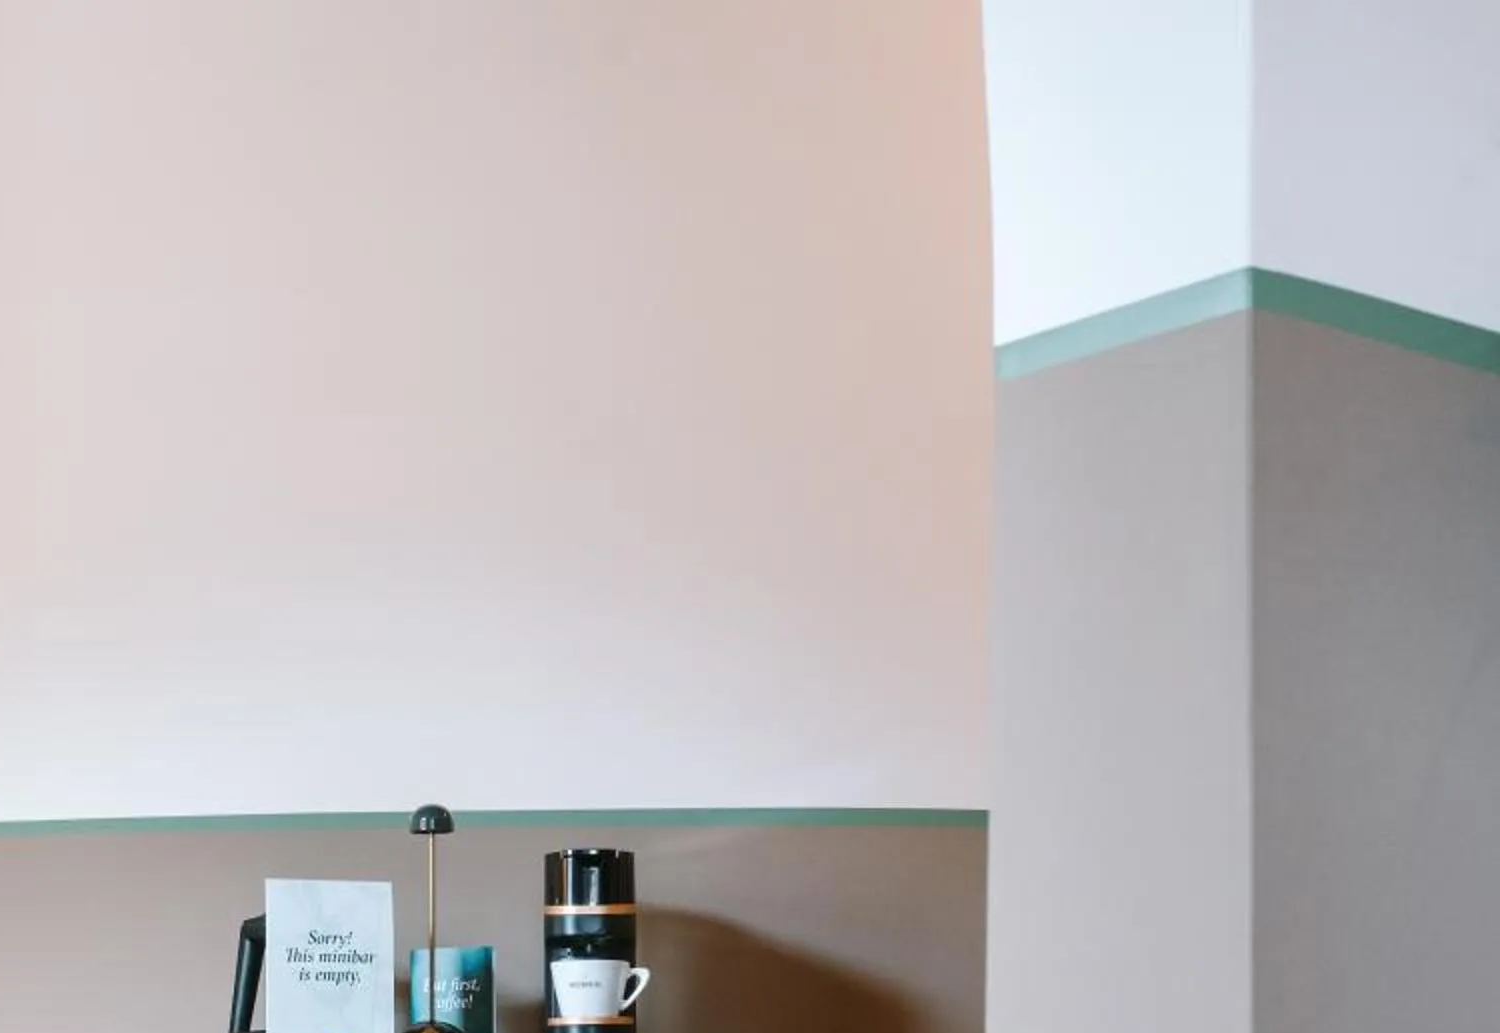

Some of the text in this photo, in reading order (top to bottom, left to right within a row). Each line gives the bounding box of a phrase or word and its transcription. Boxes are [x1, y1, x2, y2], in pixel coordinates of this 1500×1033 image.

[308, 929, 353, 949] Sorry!
[286, 947, 376, 963] This minibar
[299, 967, 311, 981] is
[450, 976, 481, 993] first,
[432, 992, 473, 1013] offee!
